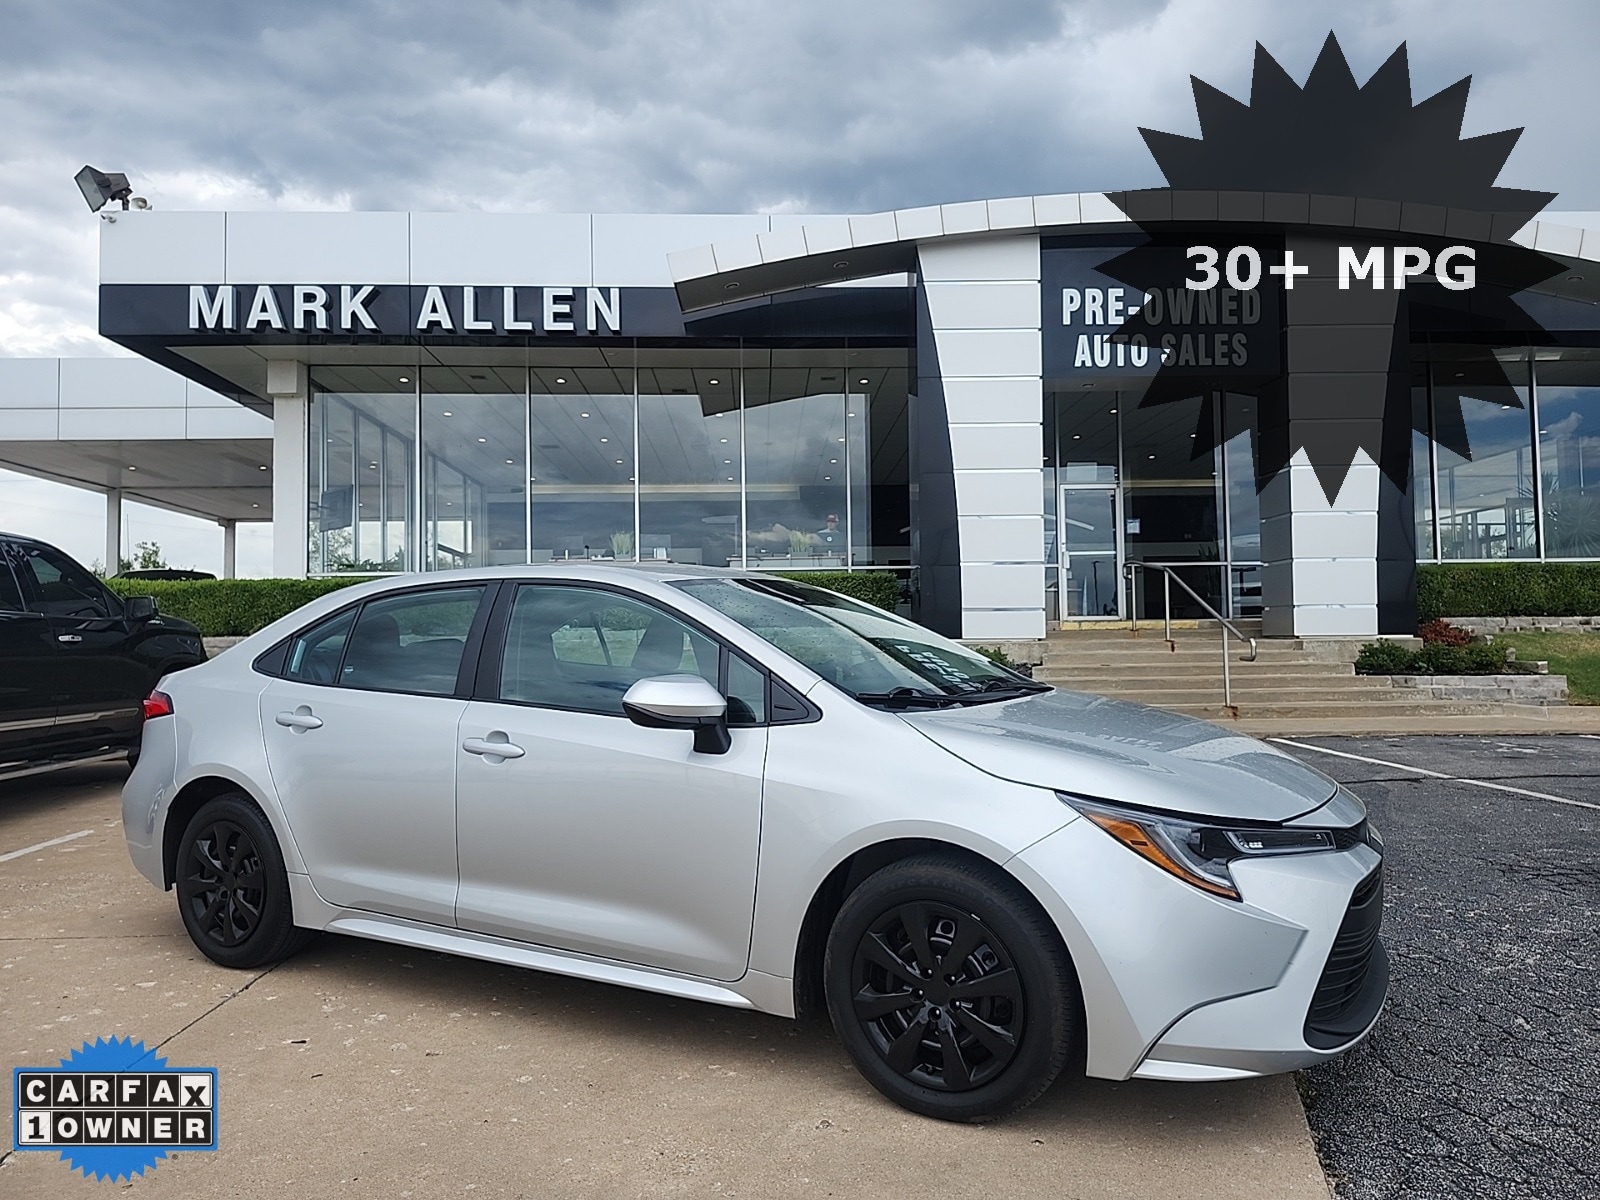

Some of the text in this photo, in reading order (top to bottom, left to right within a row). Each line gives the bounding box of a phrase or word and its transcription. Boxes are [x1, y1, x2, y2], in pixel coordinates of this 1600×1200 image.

[189, 286, 621, 331] MARK ALLEN
[1062, 287, 1261, 325] PRE-OWNED
[1074, 333, 1248, 367] AUTO SALES
